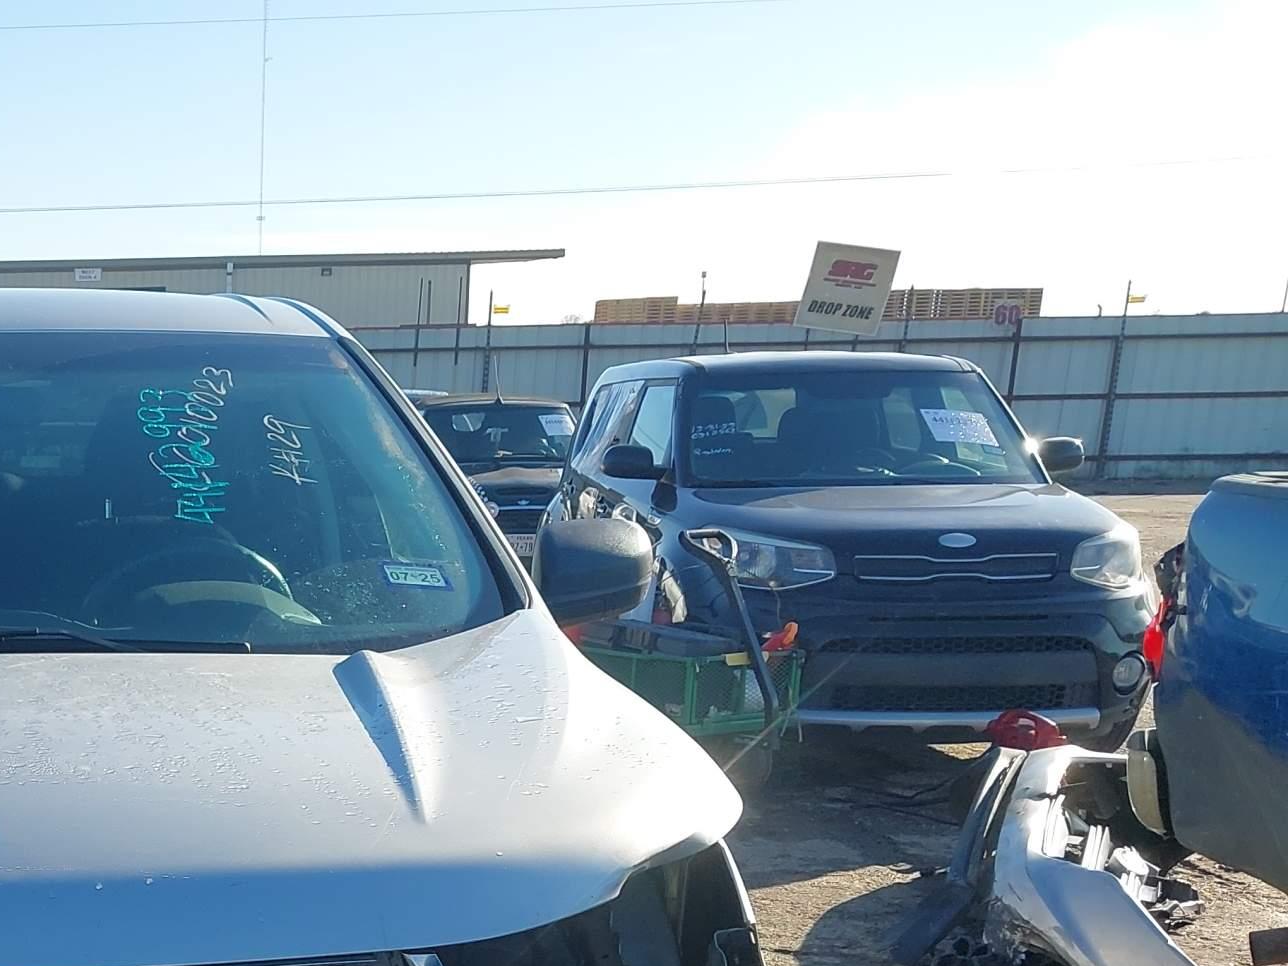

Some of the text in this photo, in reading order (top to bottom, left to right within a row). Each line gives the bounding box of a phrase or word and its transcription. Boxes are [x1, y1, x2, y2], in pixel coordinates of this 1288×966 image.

[807, 299, 875, 320] DROP ZONE
[389, 571, 441, 584] 07 25
